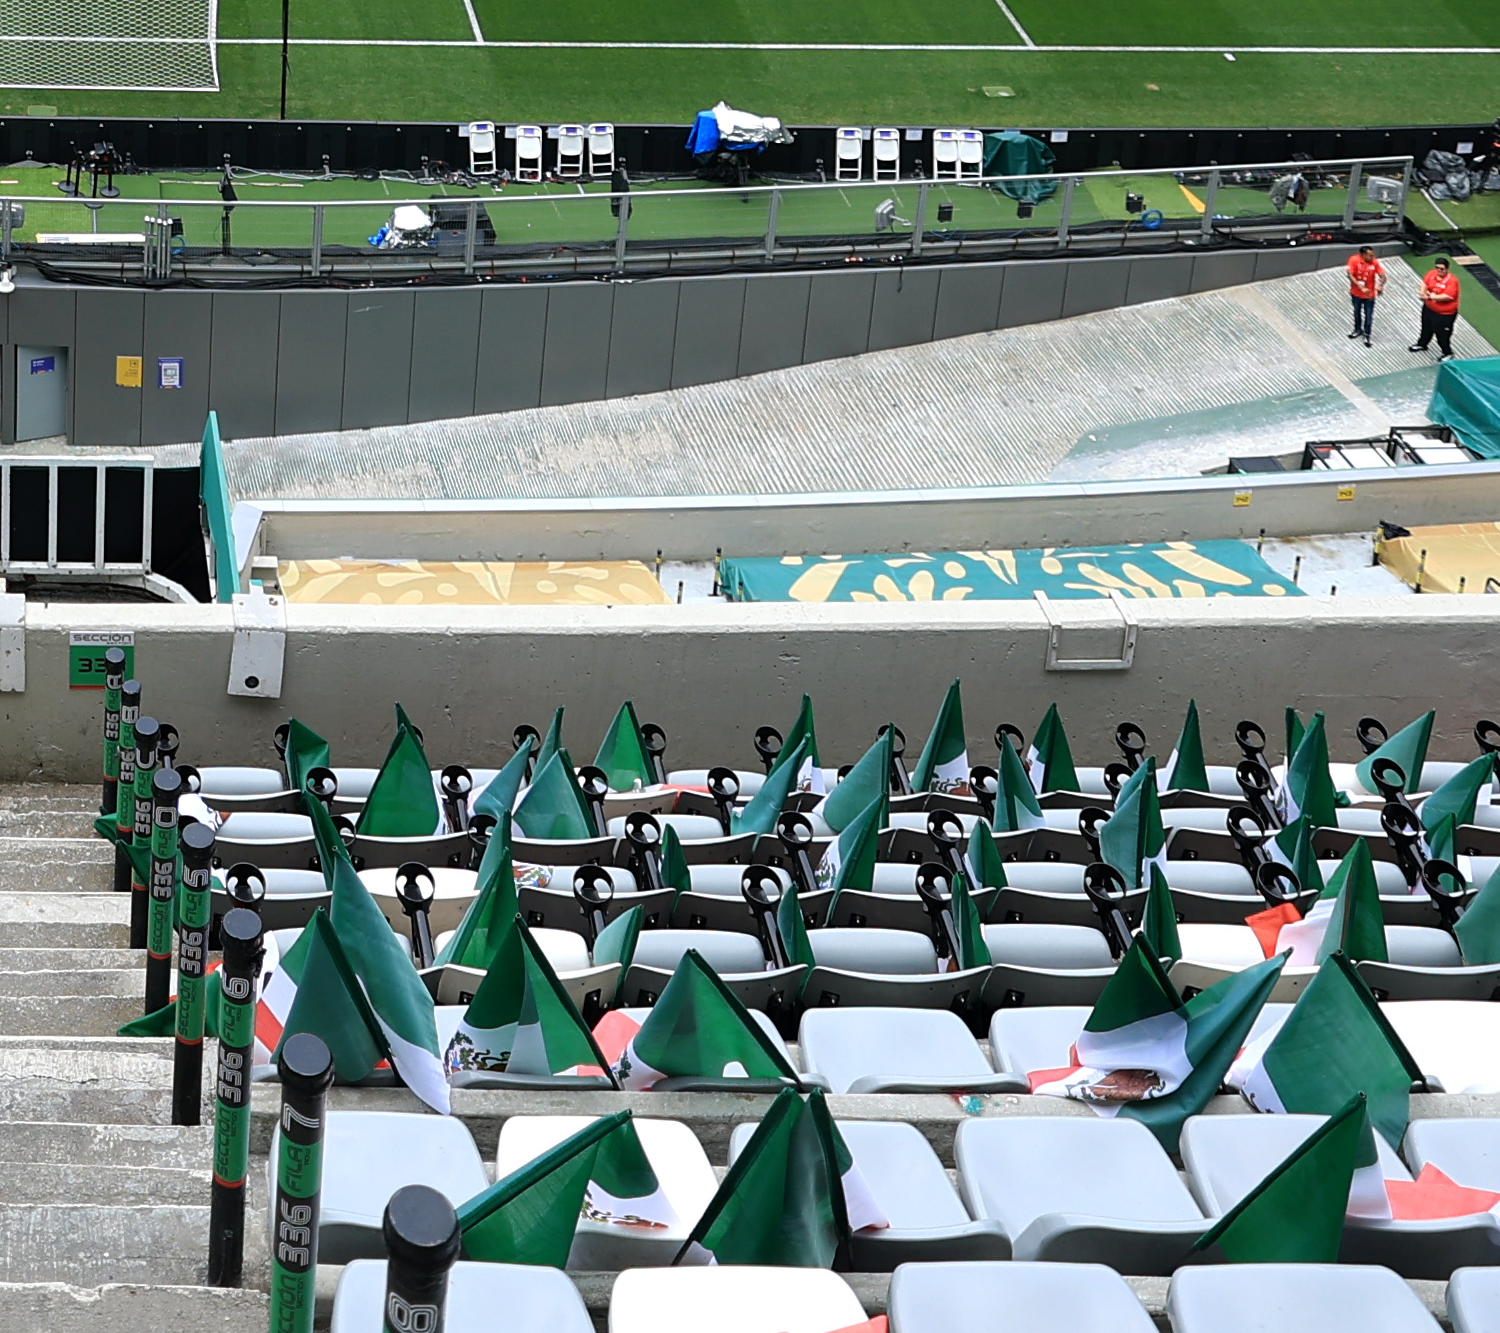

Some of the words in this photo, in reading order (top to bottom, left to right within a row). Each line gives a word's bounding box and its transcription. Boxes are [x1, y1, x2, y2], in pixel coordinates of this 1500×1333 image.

[73, 633, 132, 642] SECCIÓN
[78, 658, 106, 673] 33
[135, 748, 155, 770] C
[134, 800, 152, 836] 336
[159, 831, 169, 858] FILA
[153, 861, 172, 899] 336
[183, 866, 209, 888] 5
[186, 892, 198, 925] FILA
[152, 903, 163, 954] SECCIÓN
[180, 929, 203, 975] 336
[177, 978, 190, 1035] SECCIÓN
[222, 975, 250, 1000] 6
[221, 1003, 234, 1043] FILA
[217, 1051, 243, 1104] 336
[282, 1102, 321, 1131] 7
[216, 1107, 231, 1178] SECCIÓN
[284, 1144, 302, 1193] FILA
[277, 1202, 312, 1267] 336
[388, 1290, 439, 1333] 8
